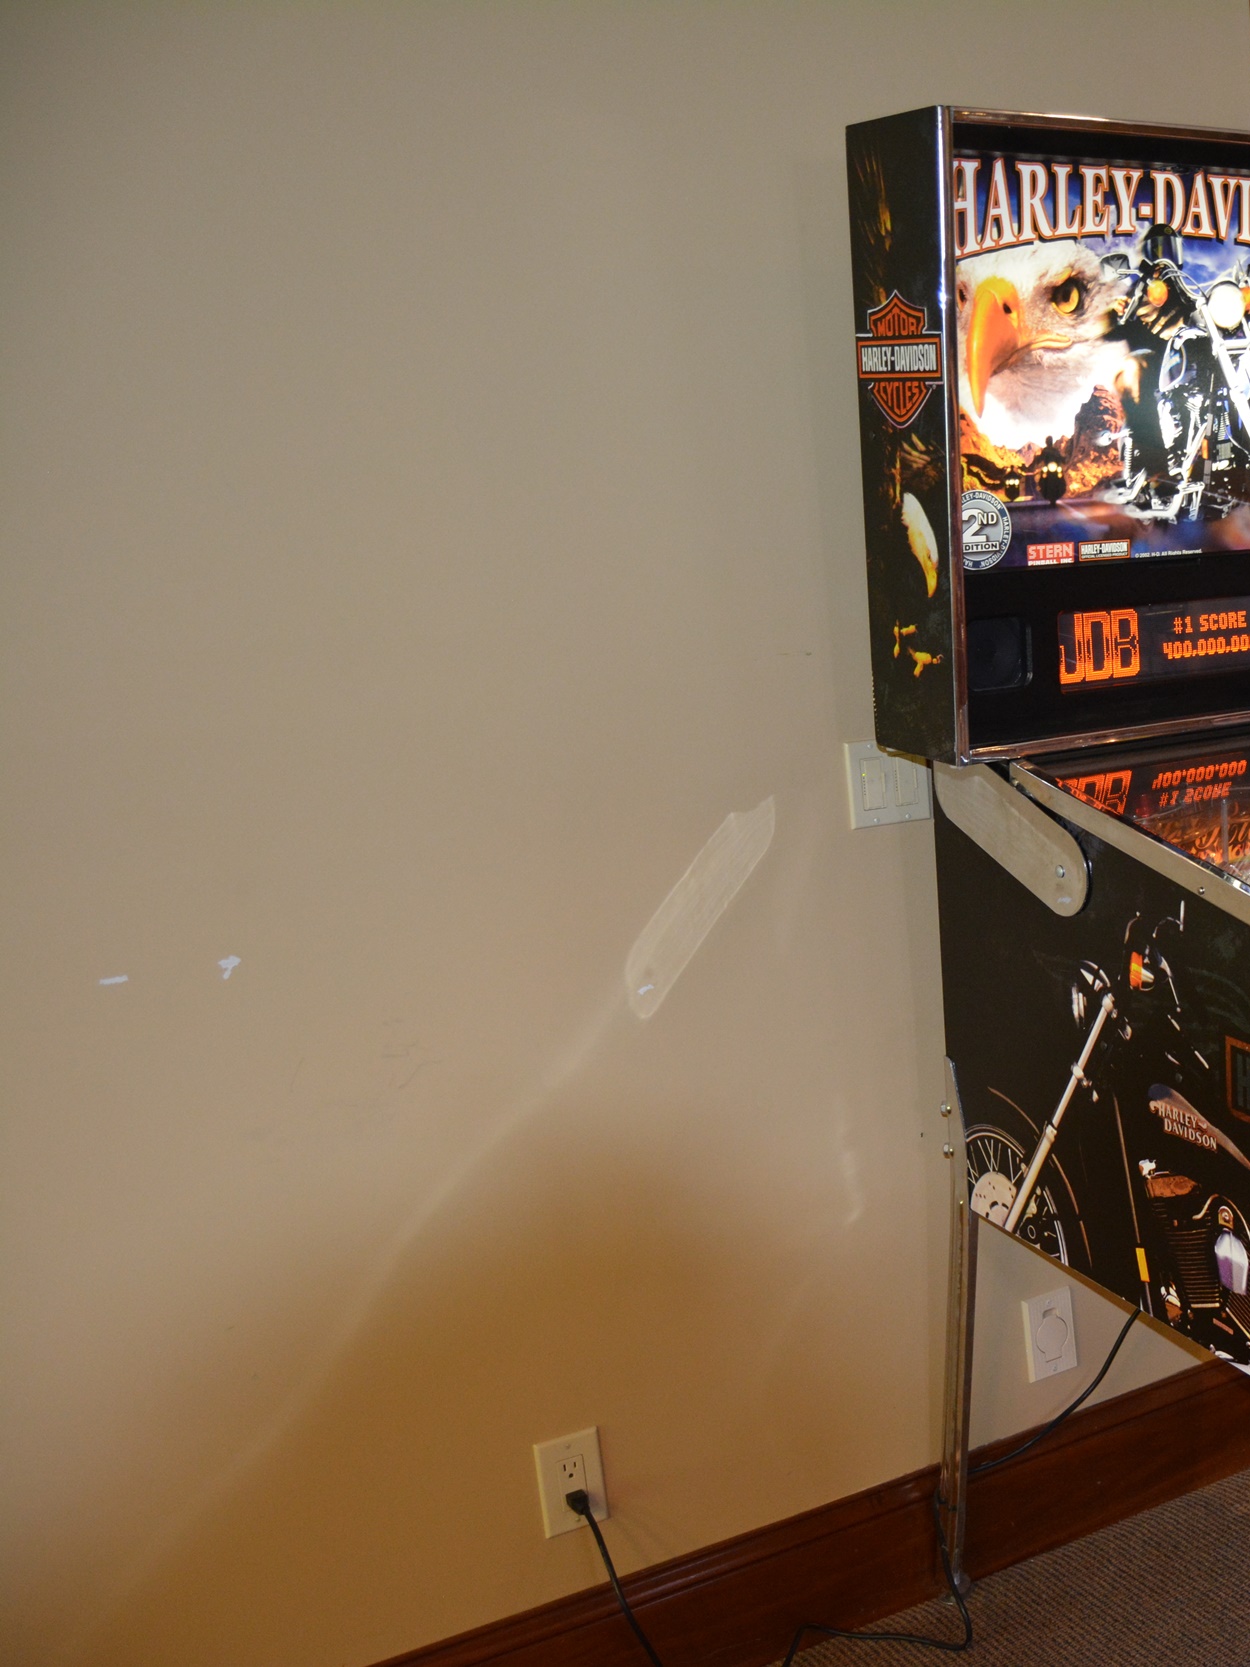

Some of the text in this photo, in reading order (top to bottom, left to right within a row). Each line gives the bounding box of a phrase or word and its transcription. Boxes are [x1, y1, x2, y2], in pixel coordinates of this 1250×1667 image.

[877, 305, 918, 337] MOTOR
[861, 343, 938, 373] HARLEY-DAVIDSON
[879, 381, 920, 417] CYCLES
[962, 508, 998, 543] 2ND
[963, 543, 998, 552] DITION
[1028, 542, 1074, 560] STERN
[1081, 542, 1128, 555] HARLEY-DAVIDSON
[1174, 610, 1247, 634] #1 SCORE
[1060, 609, 1140, 684] JDB
[1158, 1101, 1197, 1128] HARLEY
[1164, 1118, 1217, 1150] DAVIDSON
